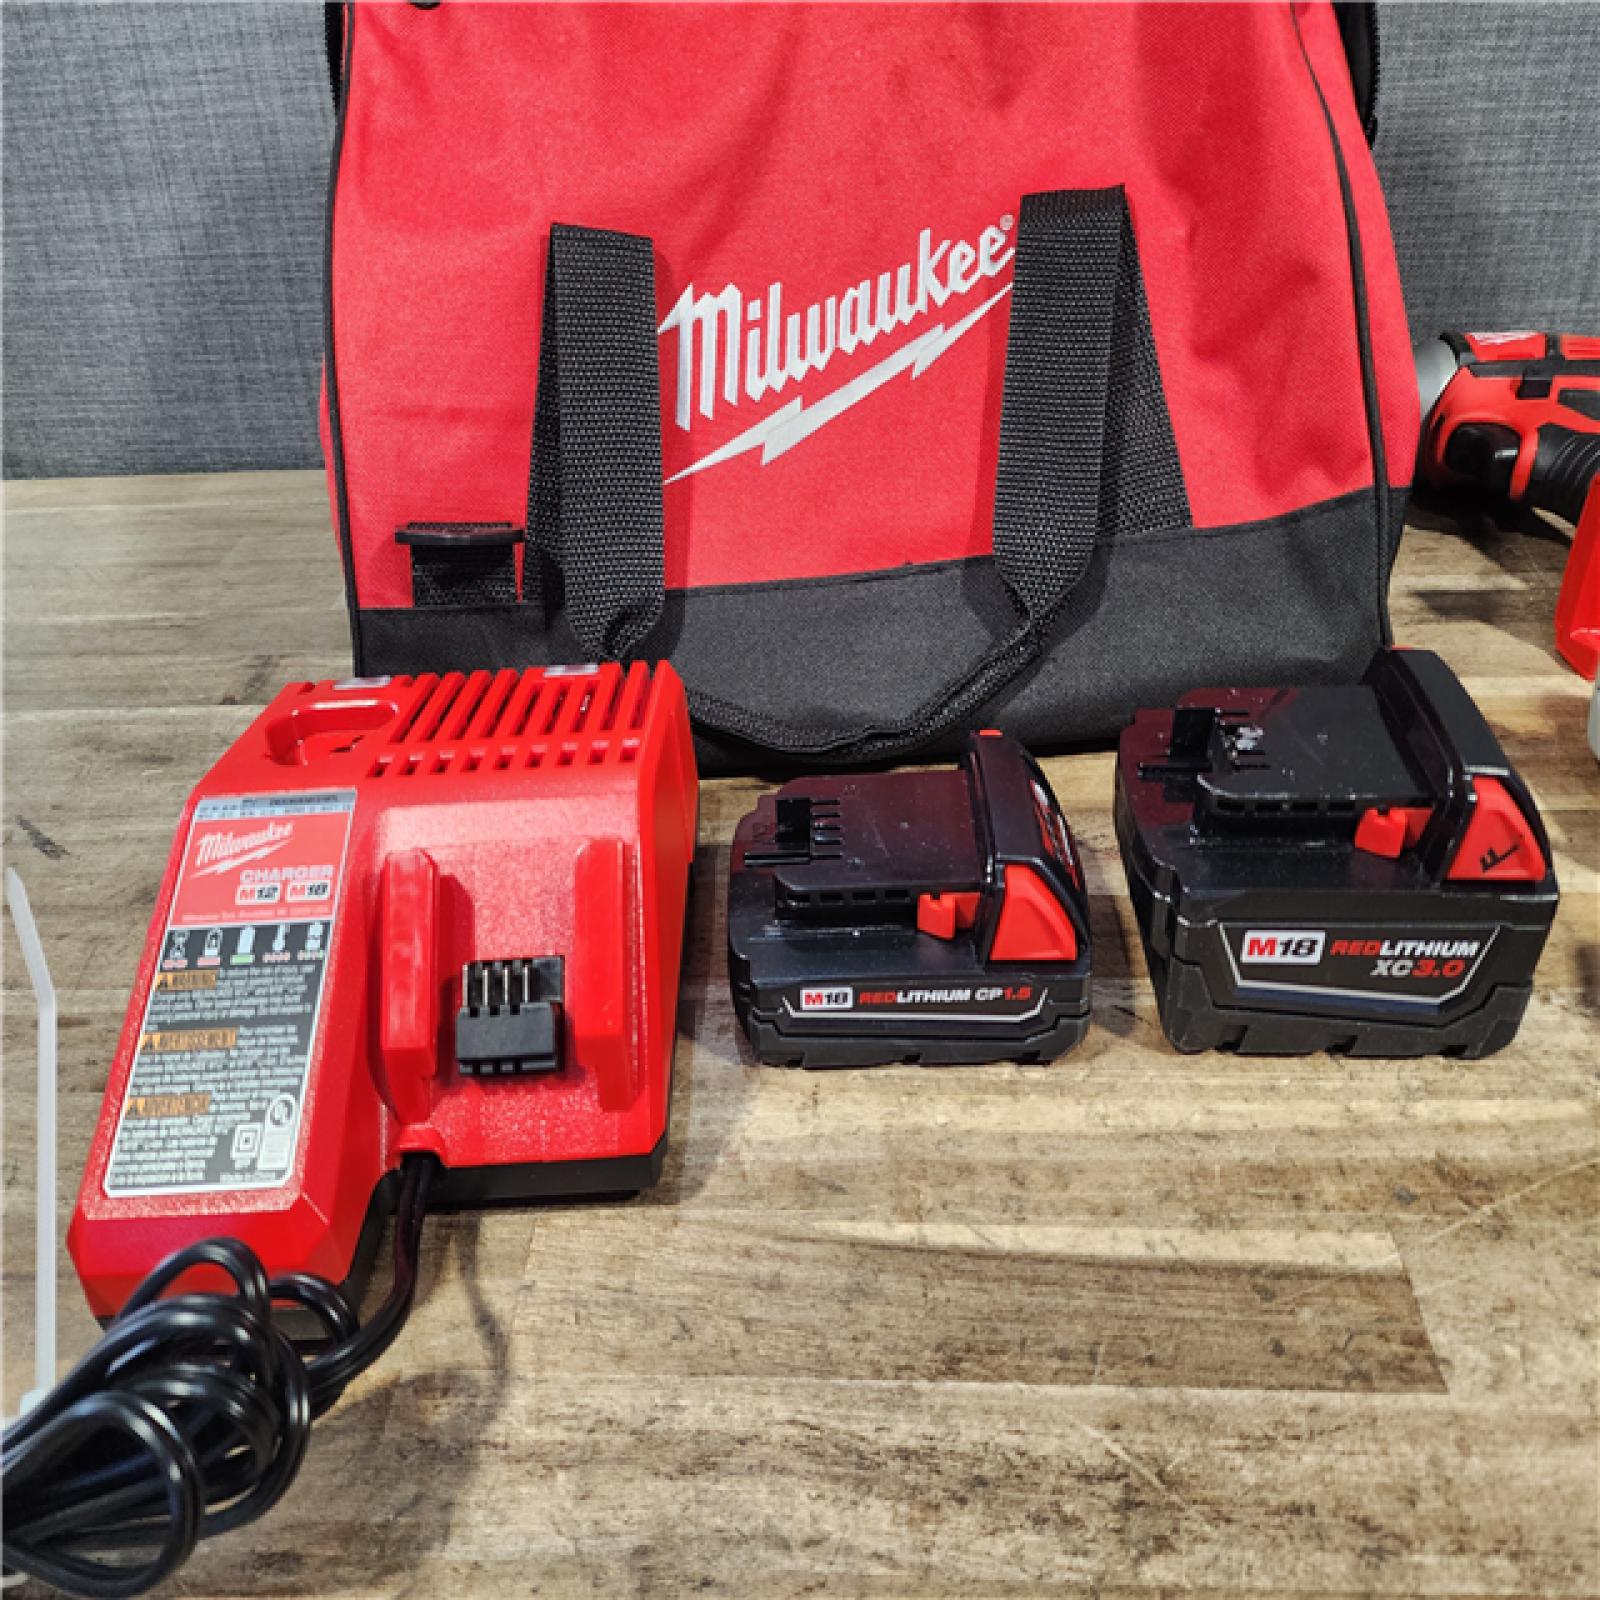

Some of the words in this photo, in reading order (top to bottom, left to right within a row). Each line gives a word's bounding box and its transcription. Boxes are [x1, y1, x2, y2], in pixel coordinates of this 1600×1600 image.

[658, 222, 1015, 431] Milwaukee
[194, 821, 294, 867] Milwaukee
[1246, 936, 1319, 957] M18
[1330, 939, 1481, 957] REDLITHIUM
[1370, 959, 1466, 977] XC3.0
[804, 991, 849, 1006] M18
[859, 988, 970, 1005] REDLITHIUM
